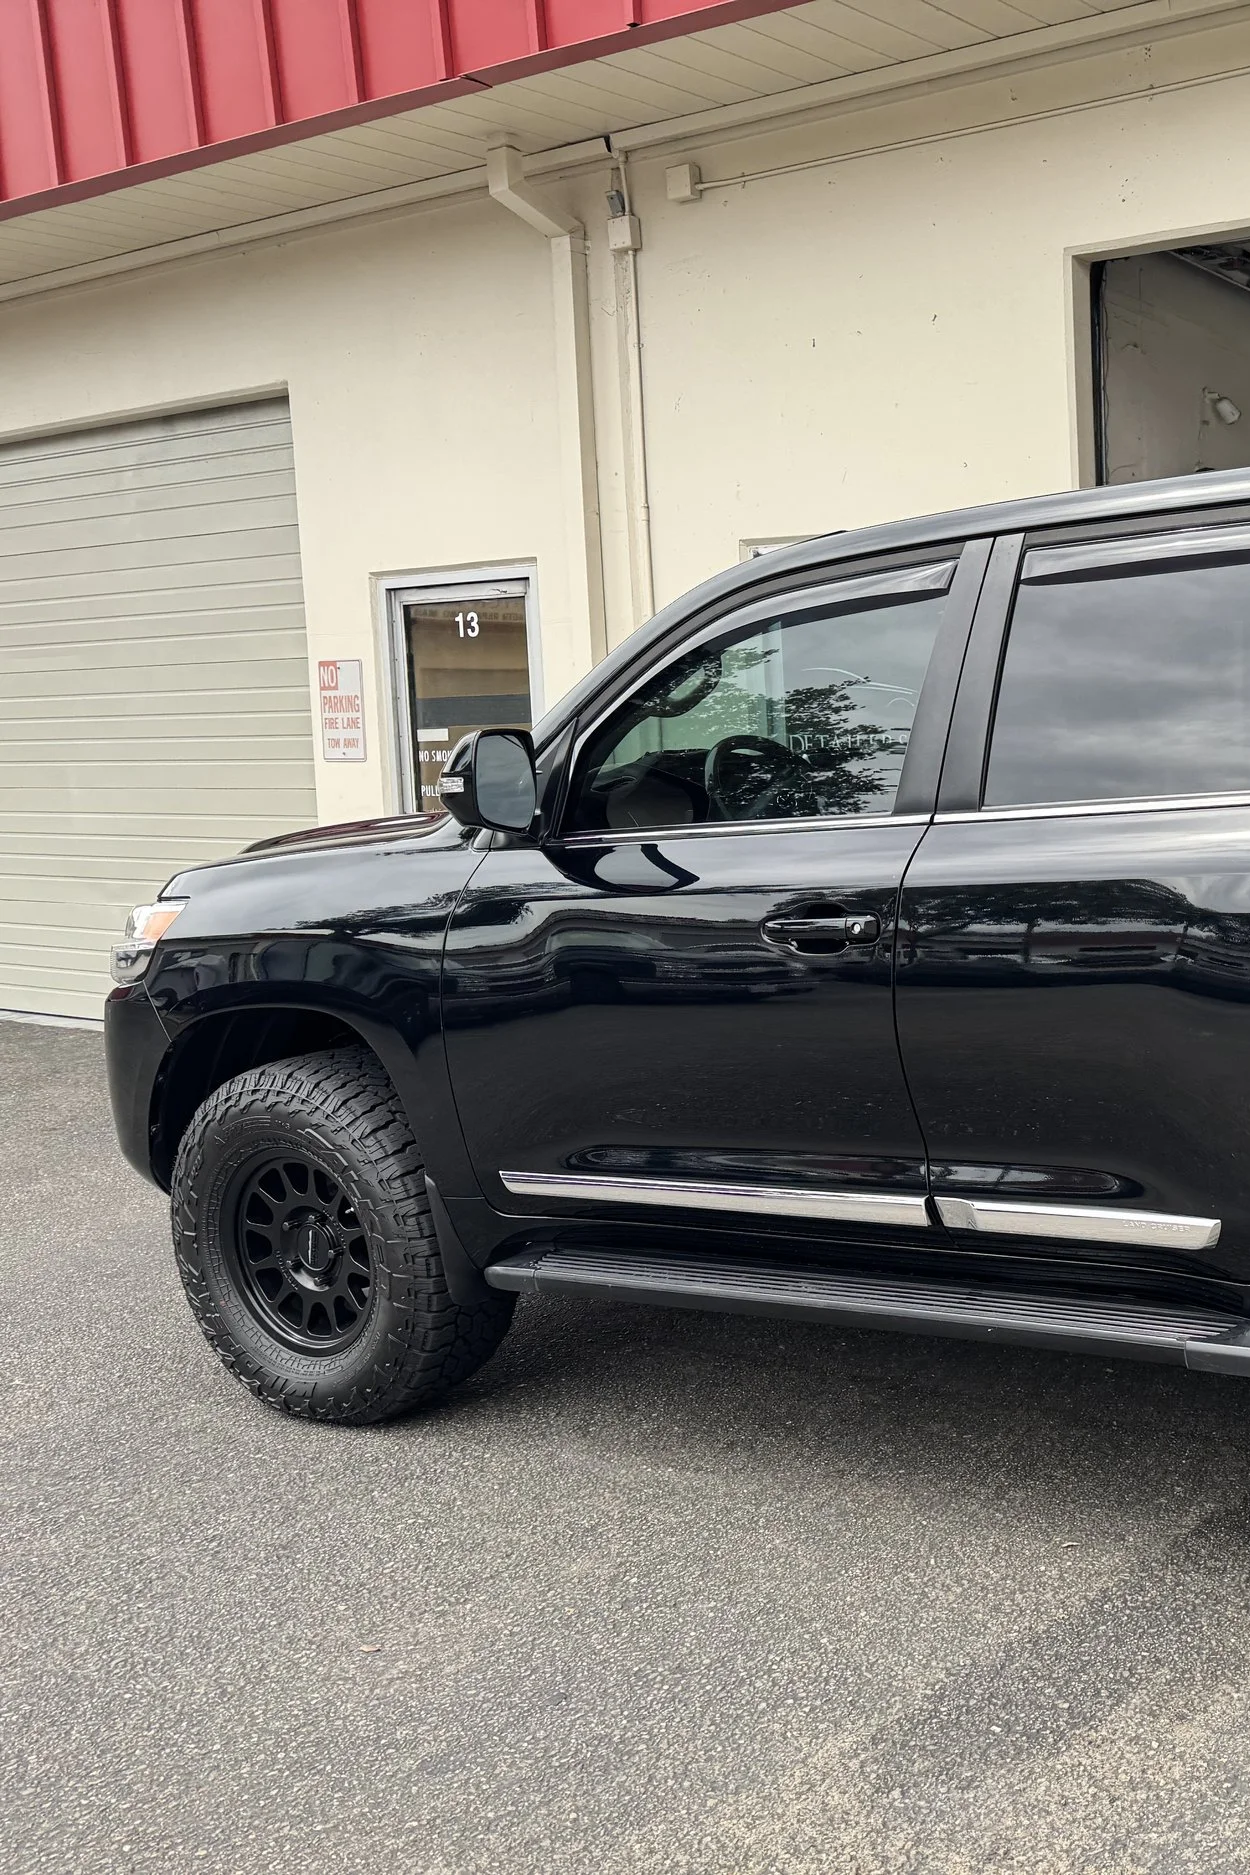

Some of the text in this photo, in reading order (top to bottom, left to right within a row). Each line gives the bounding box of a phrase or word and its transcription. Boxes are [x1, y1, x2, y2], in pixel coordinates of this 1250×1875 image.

[455, 611, 480, 638] 13
[320, 665, 337, 687] NO
[323, 695, 360, 713] PARKING
[325, 717, 361, 730] FIRE LANE
[327, 738, 360, 749] TOW AWAY
[418, 750, 430, 762] NO
[421, 785, 440, 797] PULL
